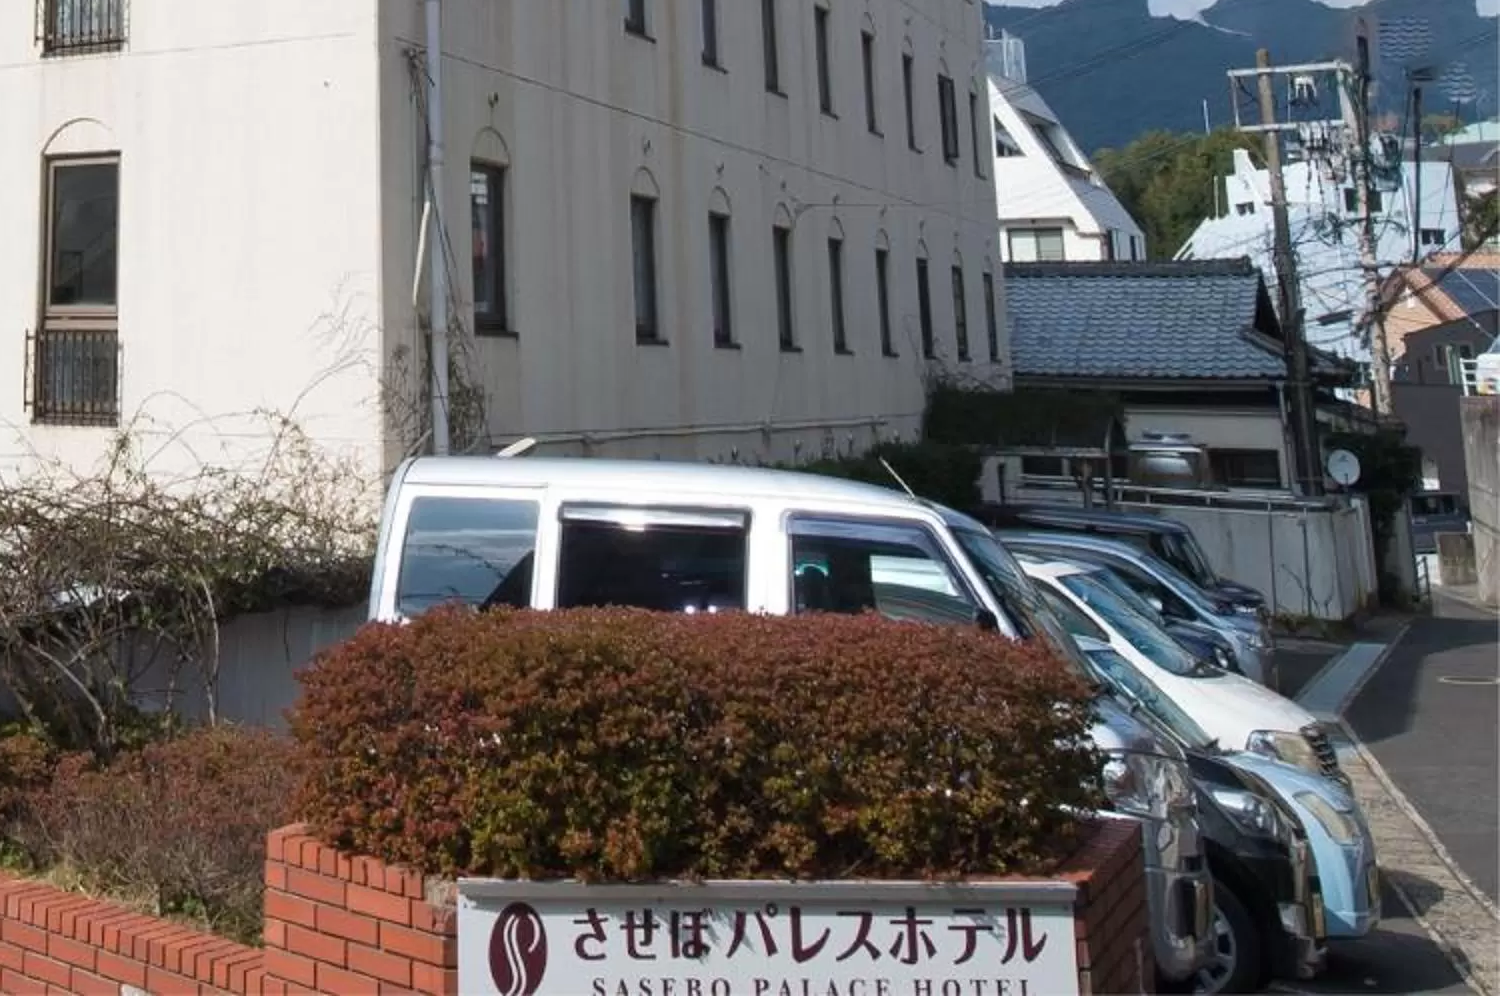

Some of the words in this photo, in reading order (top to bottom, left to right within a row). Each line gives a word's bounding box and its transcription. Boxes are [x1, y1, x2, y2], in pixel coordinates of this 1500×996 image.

[573, 903, 1048, 965] させぼパレスホテル
[592, 977, 731, 996] SASEBO
[754, 978, 891, 996] PALACE
[914, 979, 1037, 996] HOTEL
